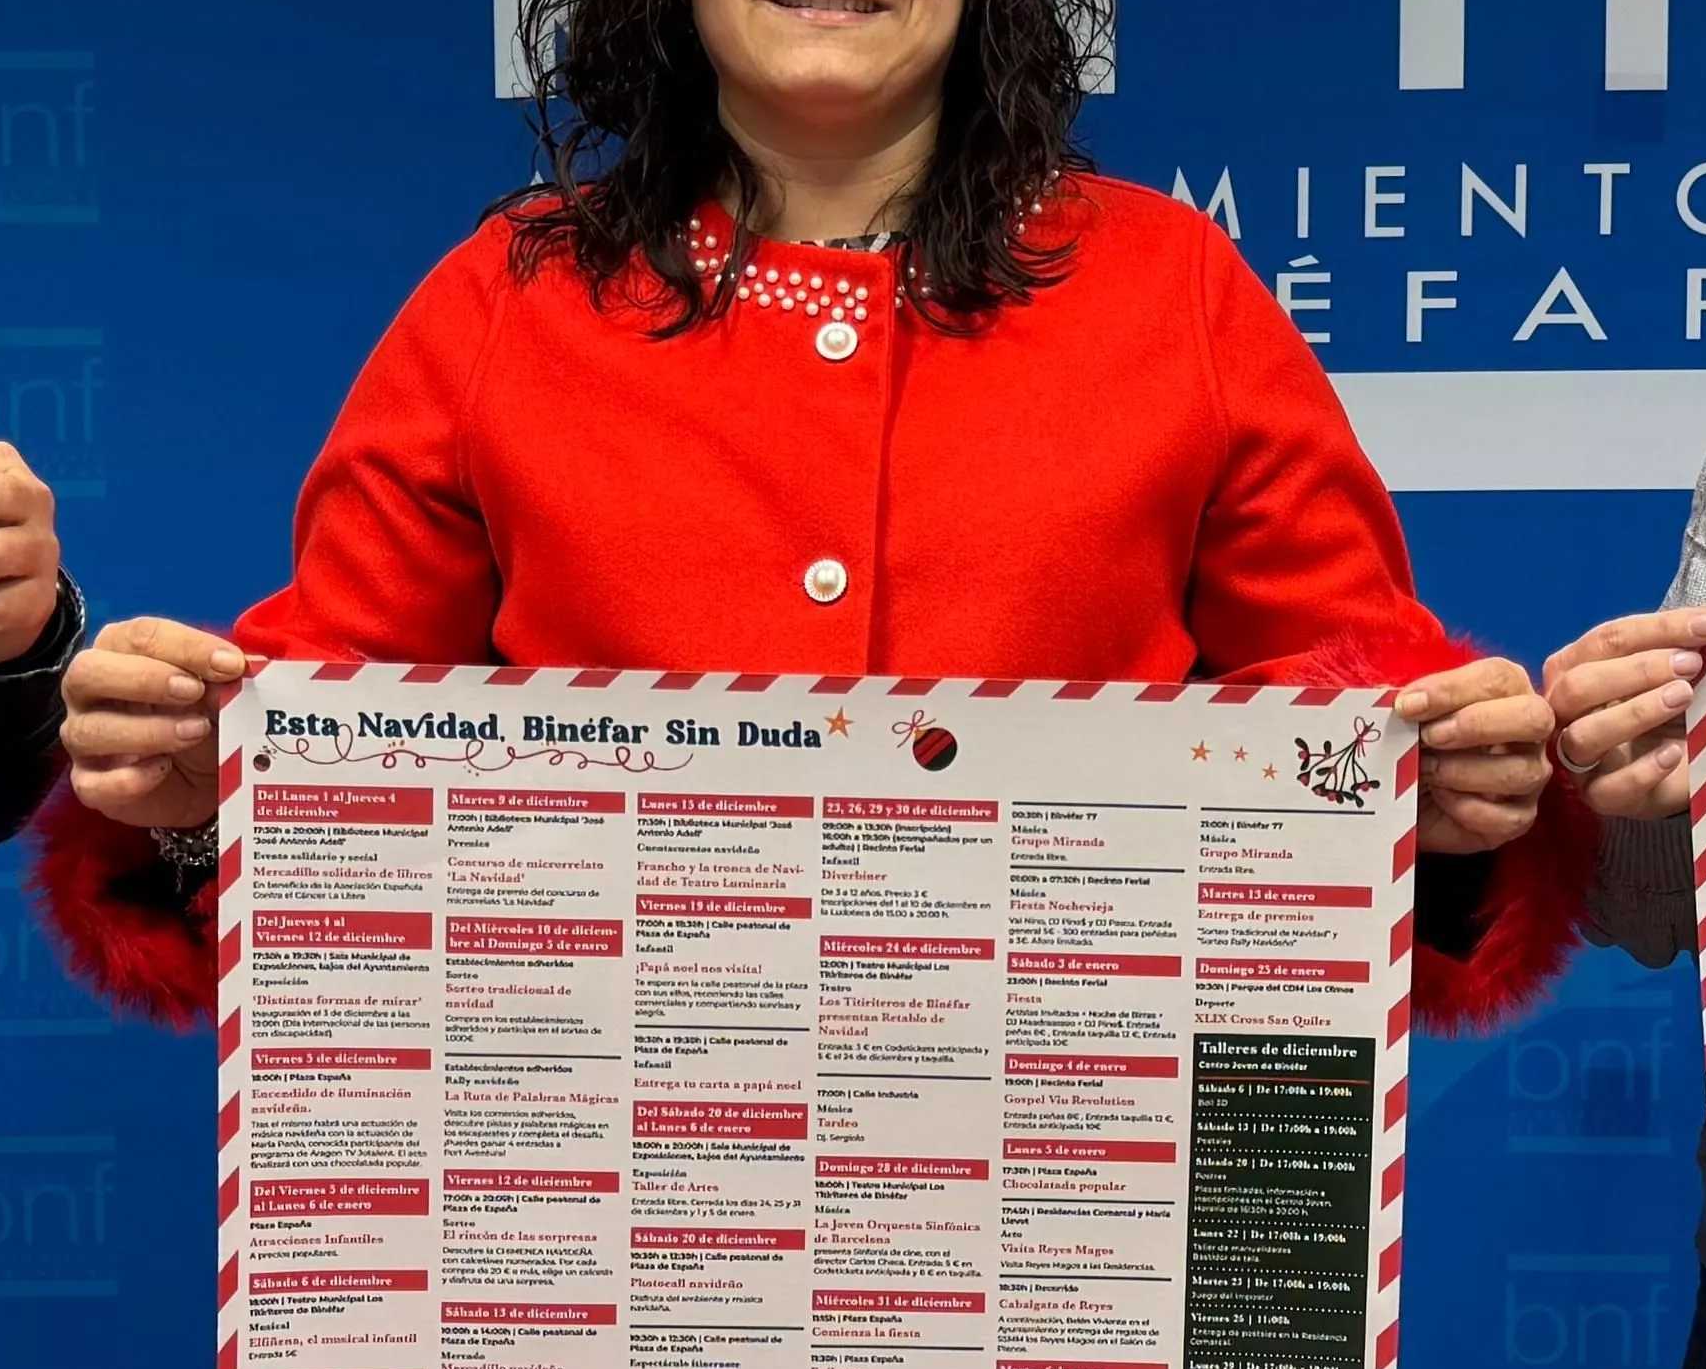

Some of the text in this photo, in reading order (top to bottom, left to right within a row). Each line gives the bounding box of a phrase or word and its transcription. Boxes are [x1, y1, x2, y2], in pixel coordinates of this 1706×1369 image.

[266, 710, 821, 748] Esta Navidad, Binéfar Sin Duda
[256, 789, 395, 804] Del Lunes 1 al Jueves 4
[450, 793, 588, 807] Martes 9 de diciembre
[256, 805, 339, 817] de diciembre
[641, 797, 777, 812] Lunes 15 de diciembre
[826, 803, 991, 816] 23, 26, 29 y 30 de diciembre
[1010, 835, 1105, 849] Grupo Miranda
[1201, 887, 1315, 901] Martes 13 de enero
[639, 899, 786, 913] Viernes 19 de diciembre
[1009, 899, 1114, 914] Fiesta Nochevieja
[823, 940, 981, 954] Miércoles 24 de diciembre
[1010, 957, 1119, 970] Sábado 3 de enero
[1198, 1041, 1357, 1057] Talleres de diciembre
[254, 1052, 397, 1064] Viernes 5 de diciembre
[1508, 1018, 1673, 1101] bnf
[819, 1160, 971, 1175] Domingo 28 de diciembre
[252, 1274, 392, 1289] Sábado 6 de diciembre
[444, 1306, 588, 1319] Sábado 13 de diciembre
[1506, 1282, 1670, 1367] bnf
